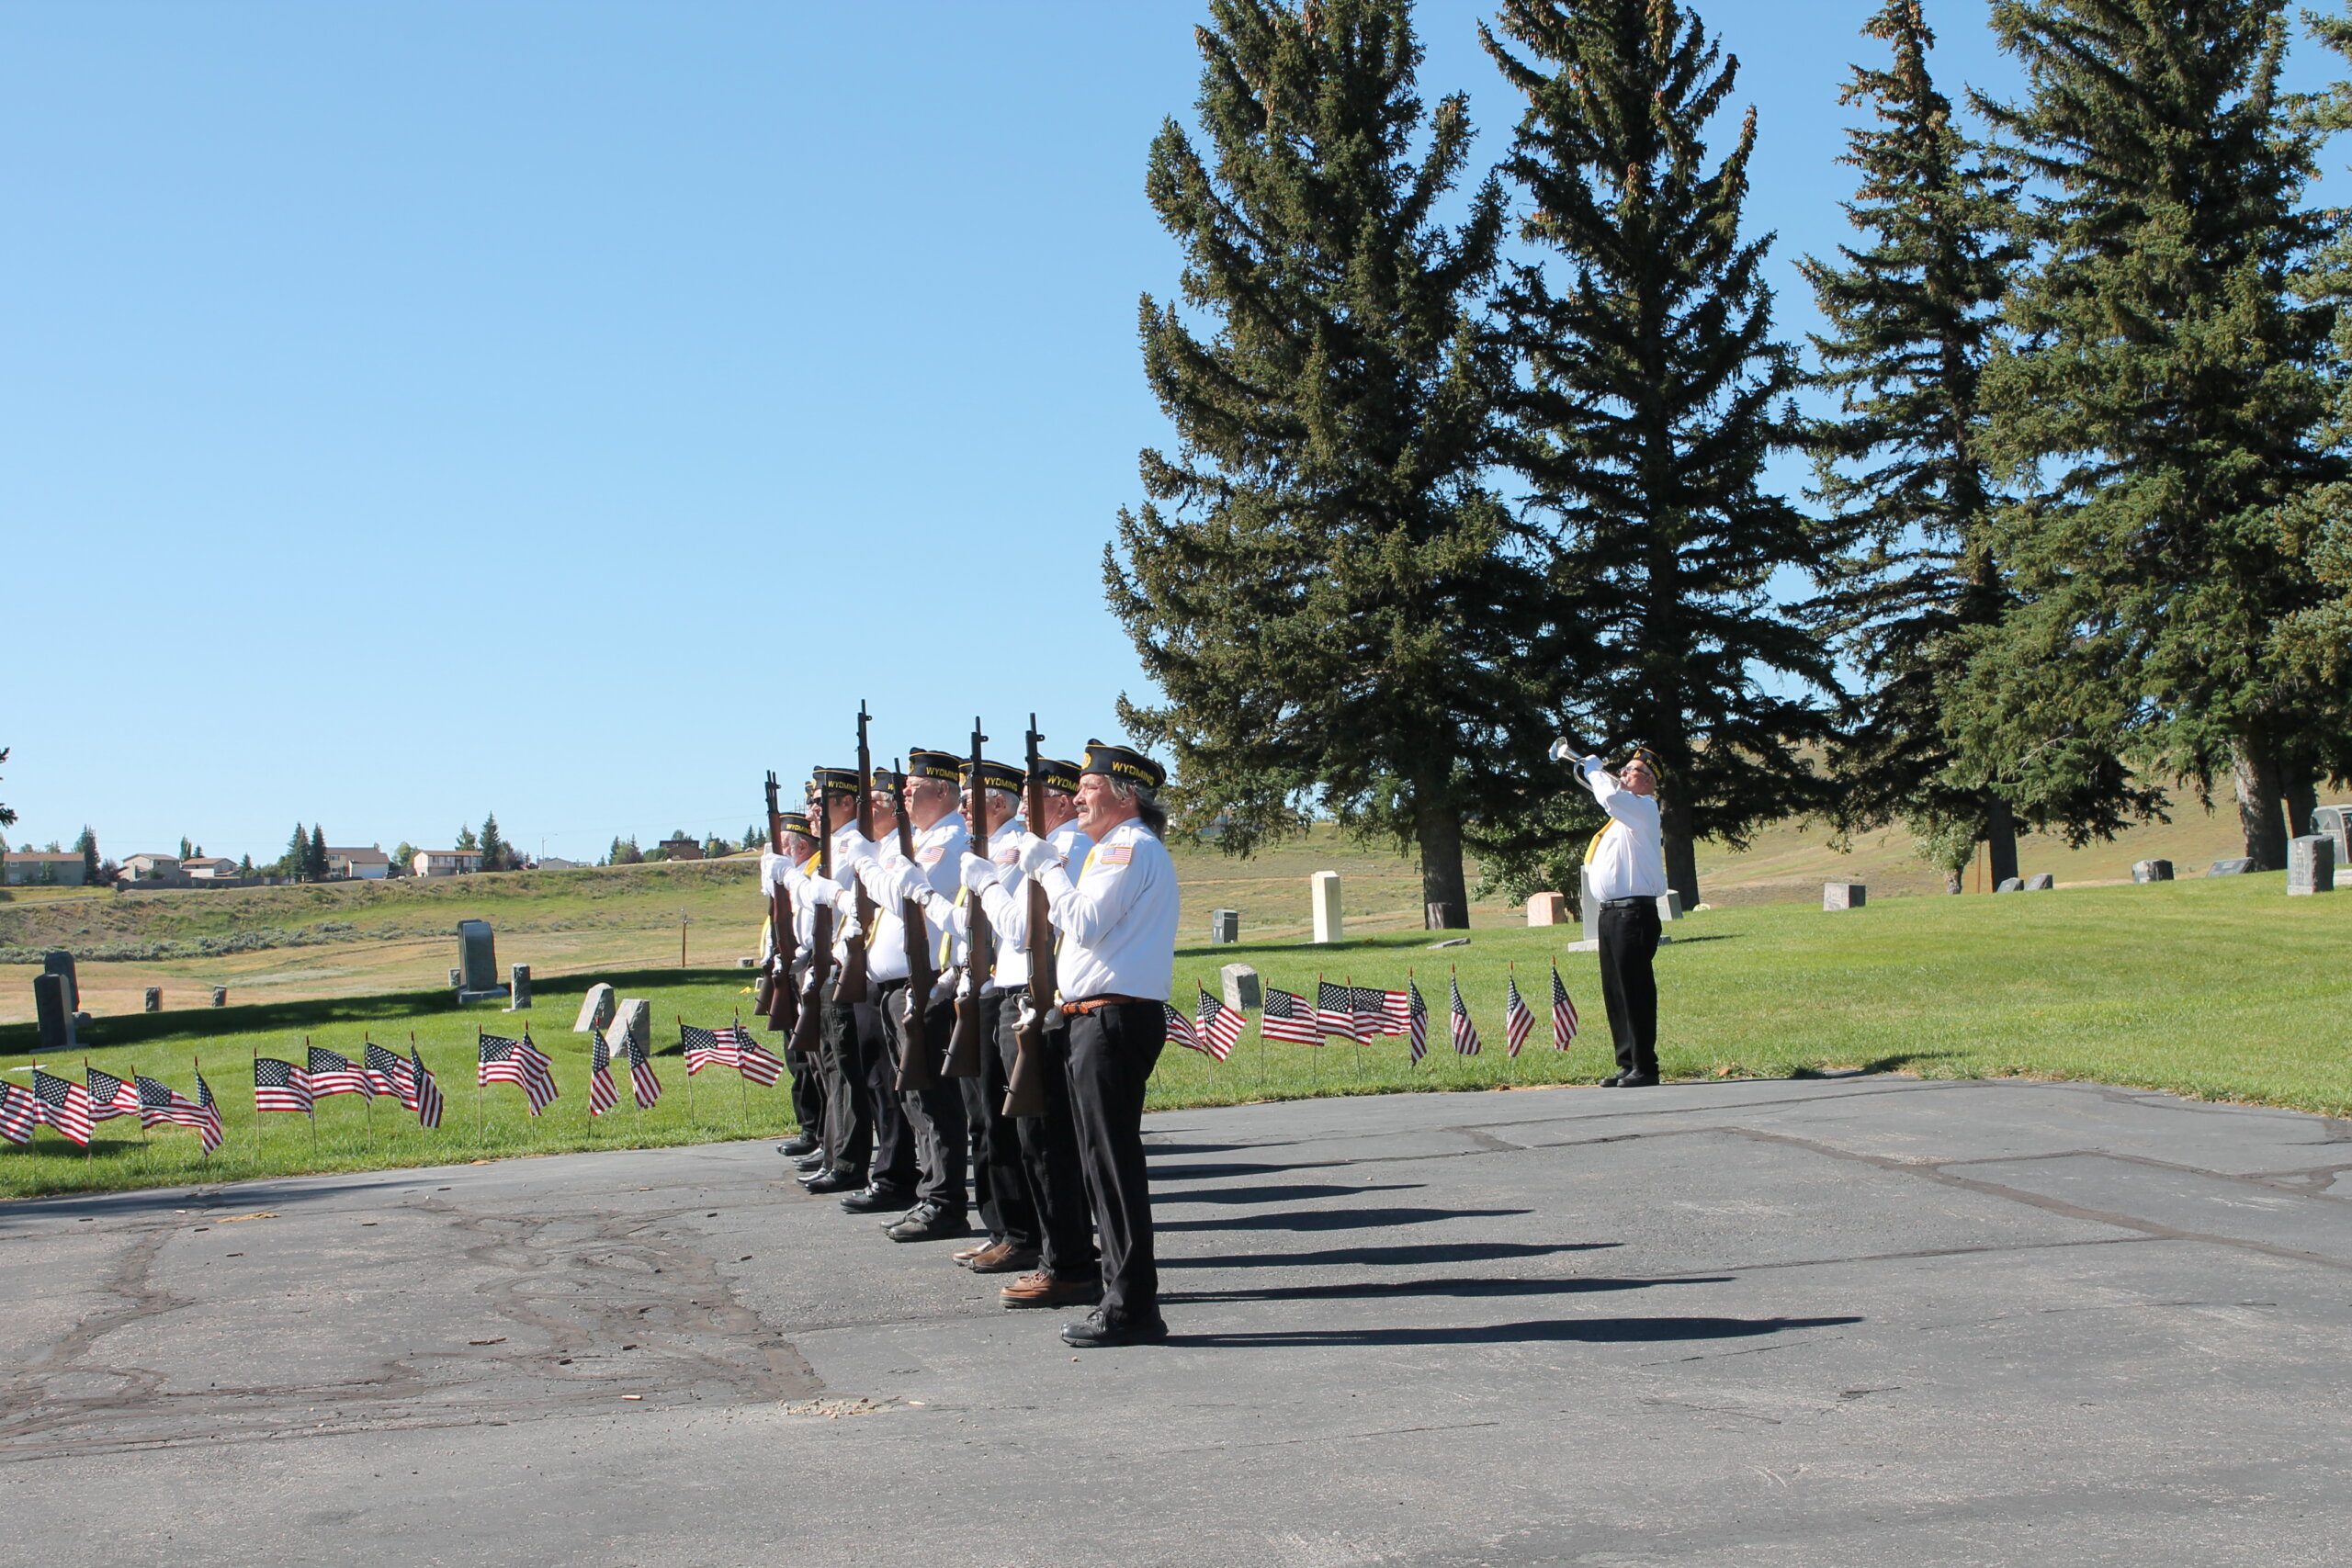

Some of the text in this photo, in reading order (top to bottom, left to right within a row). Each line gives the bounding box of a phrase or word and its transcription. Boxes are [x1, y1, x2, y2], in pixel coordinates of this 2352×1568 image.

[926, 766, 958, 781] WYOMING
[1112, 761, 1155, 786] WYOMING
[828, 780, 858, 792] WYOMING
